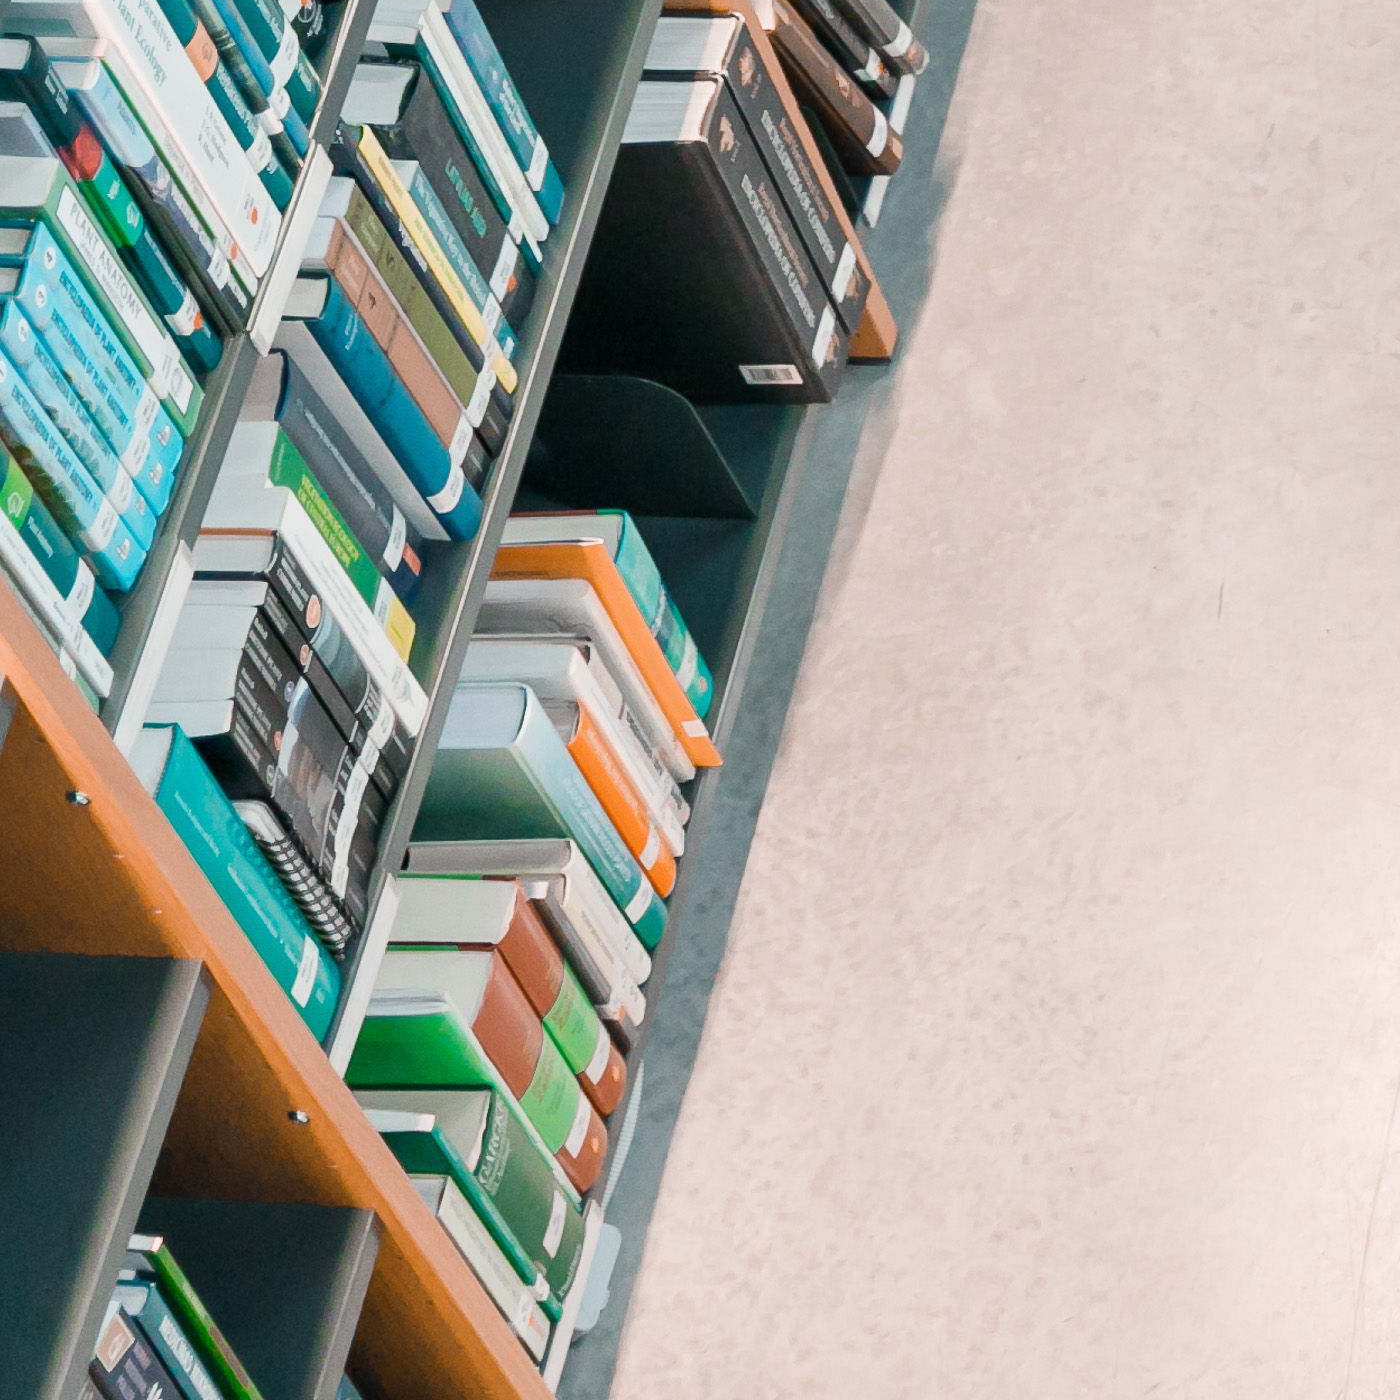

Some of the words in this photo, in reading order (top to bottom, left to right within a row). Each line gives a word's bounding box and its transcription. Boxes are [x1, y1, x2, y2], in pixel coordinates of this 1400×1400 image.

[133, 22, 169, 87] Ecology
[68, 200, 99, 253] PLANT
[97, 246, 141, 322] ANATOMY
